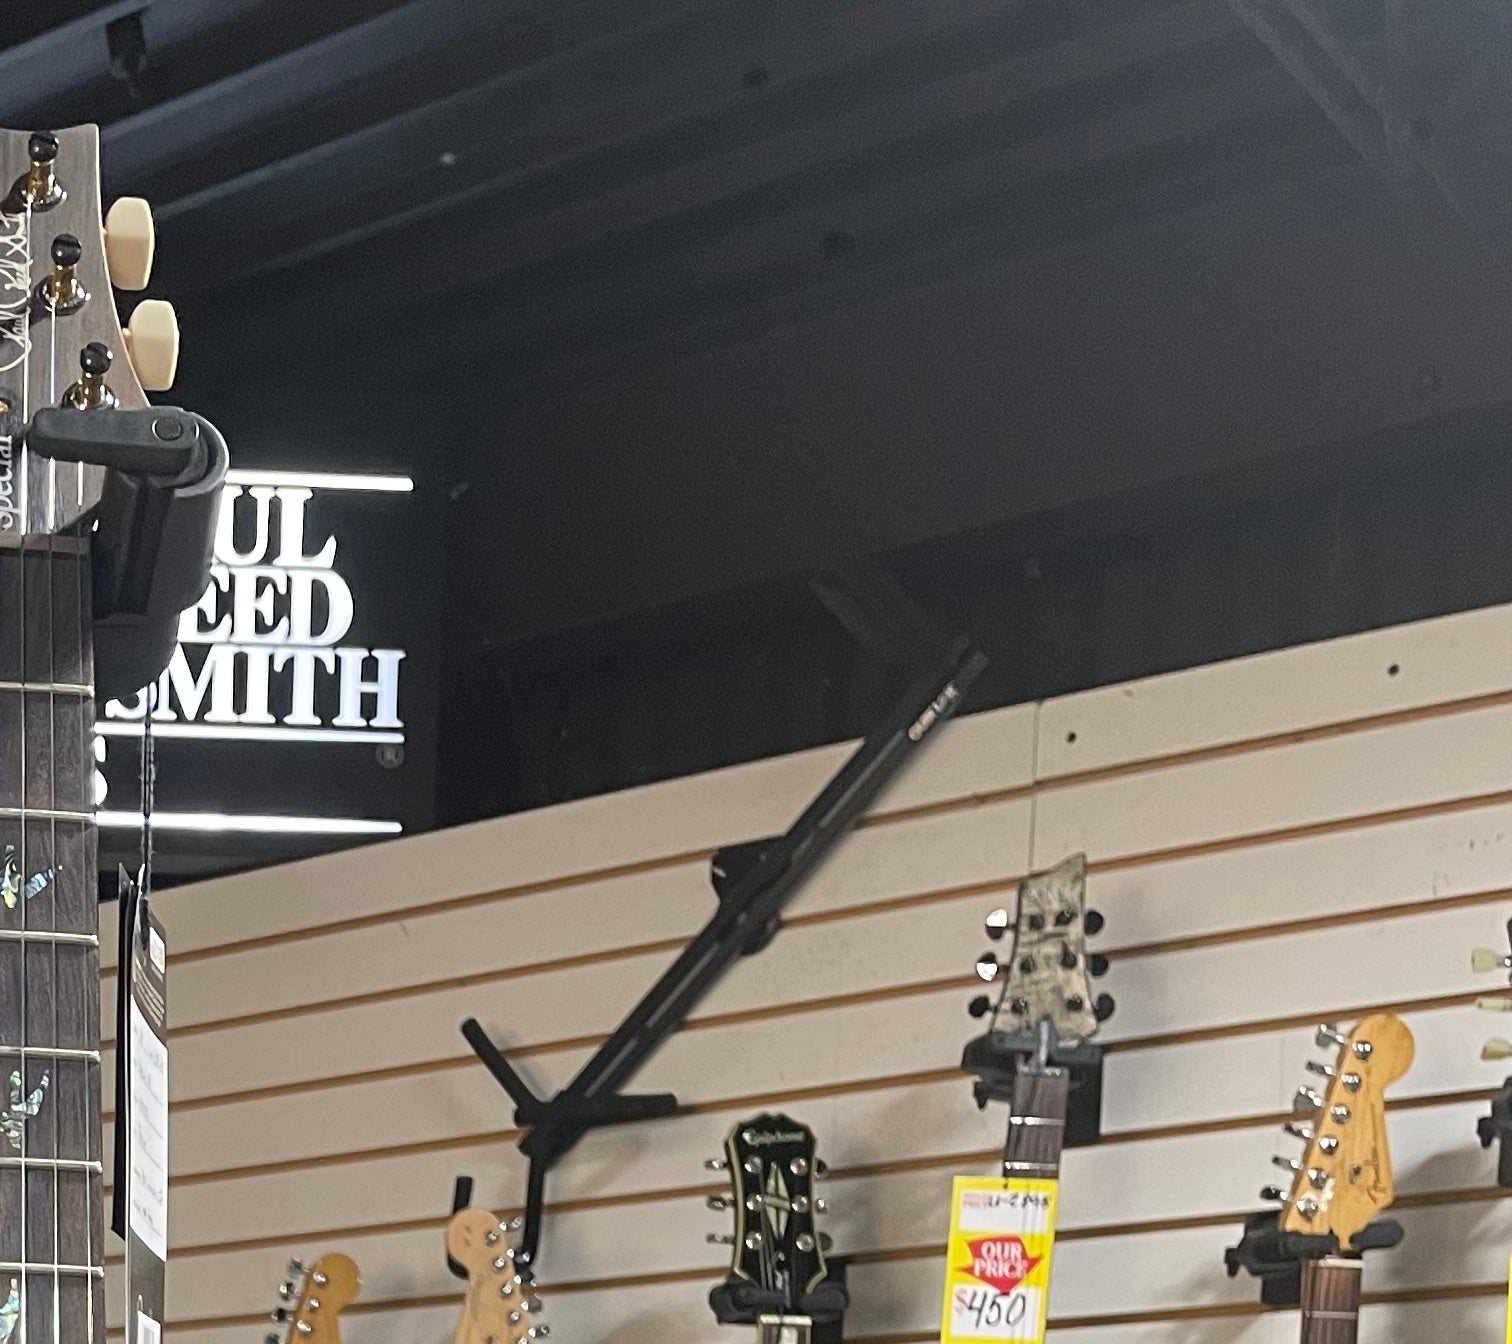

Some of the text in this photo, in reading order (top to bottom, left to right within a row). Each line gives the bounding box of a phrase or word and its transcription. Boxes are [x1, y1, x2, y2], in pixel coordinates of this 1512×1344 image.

[212, 485, 337, 568] UL
[177, 564, 354, 646] EED
[973, 1258, 1029, 1279] PRICE
[980, 1240, 1023, 1261] OUR
[955, 1287, 1027, 1329] $450
